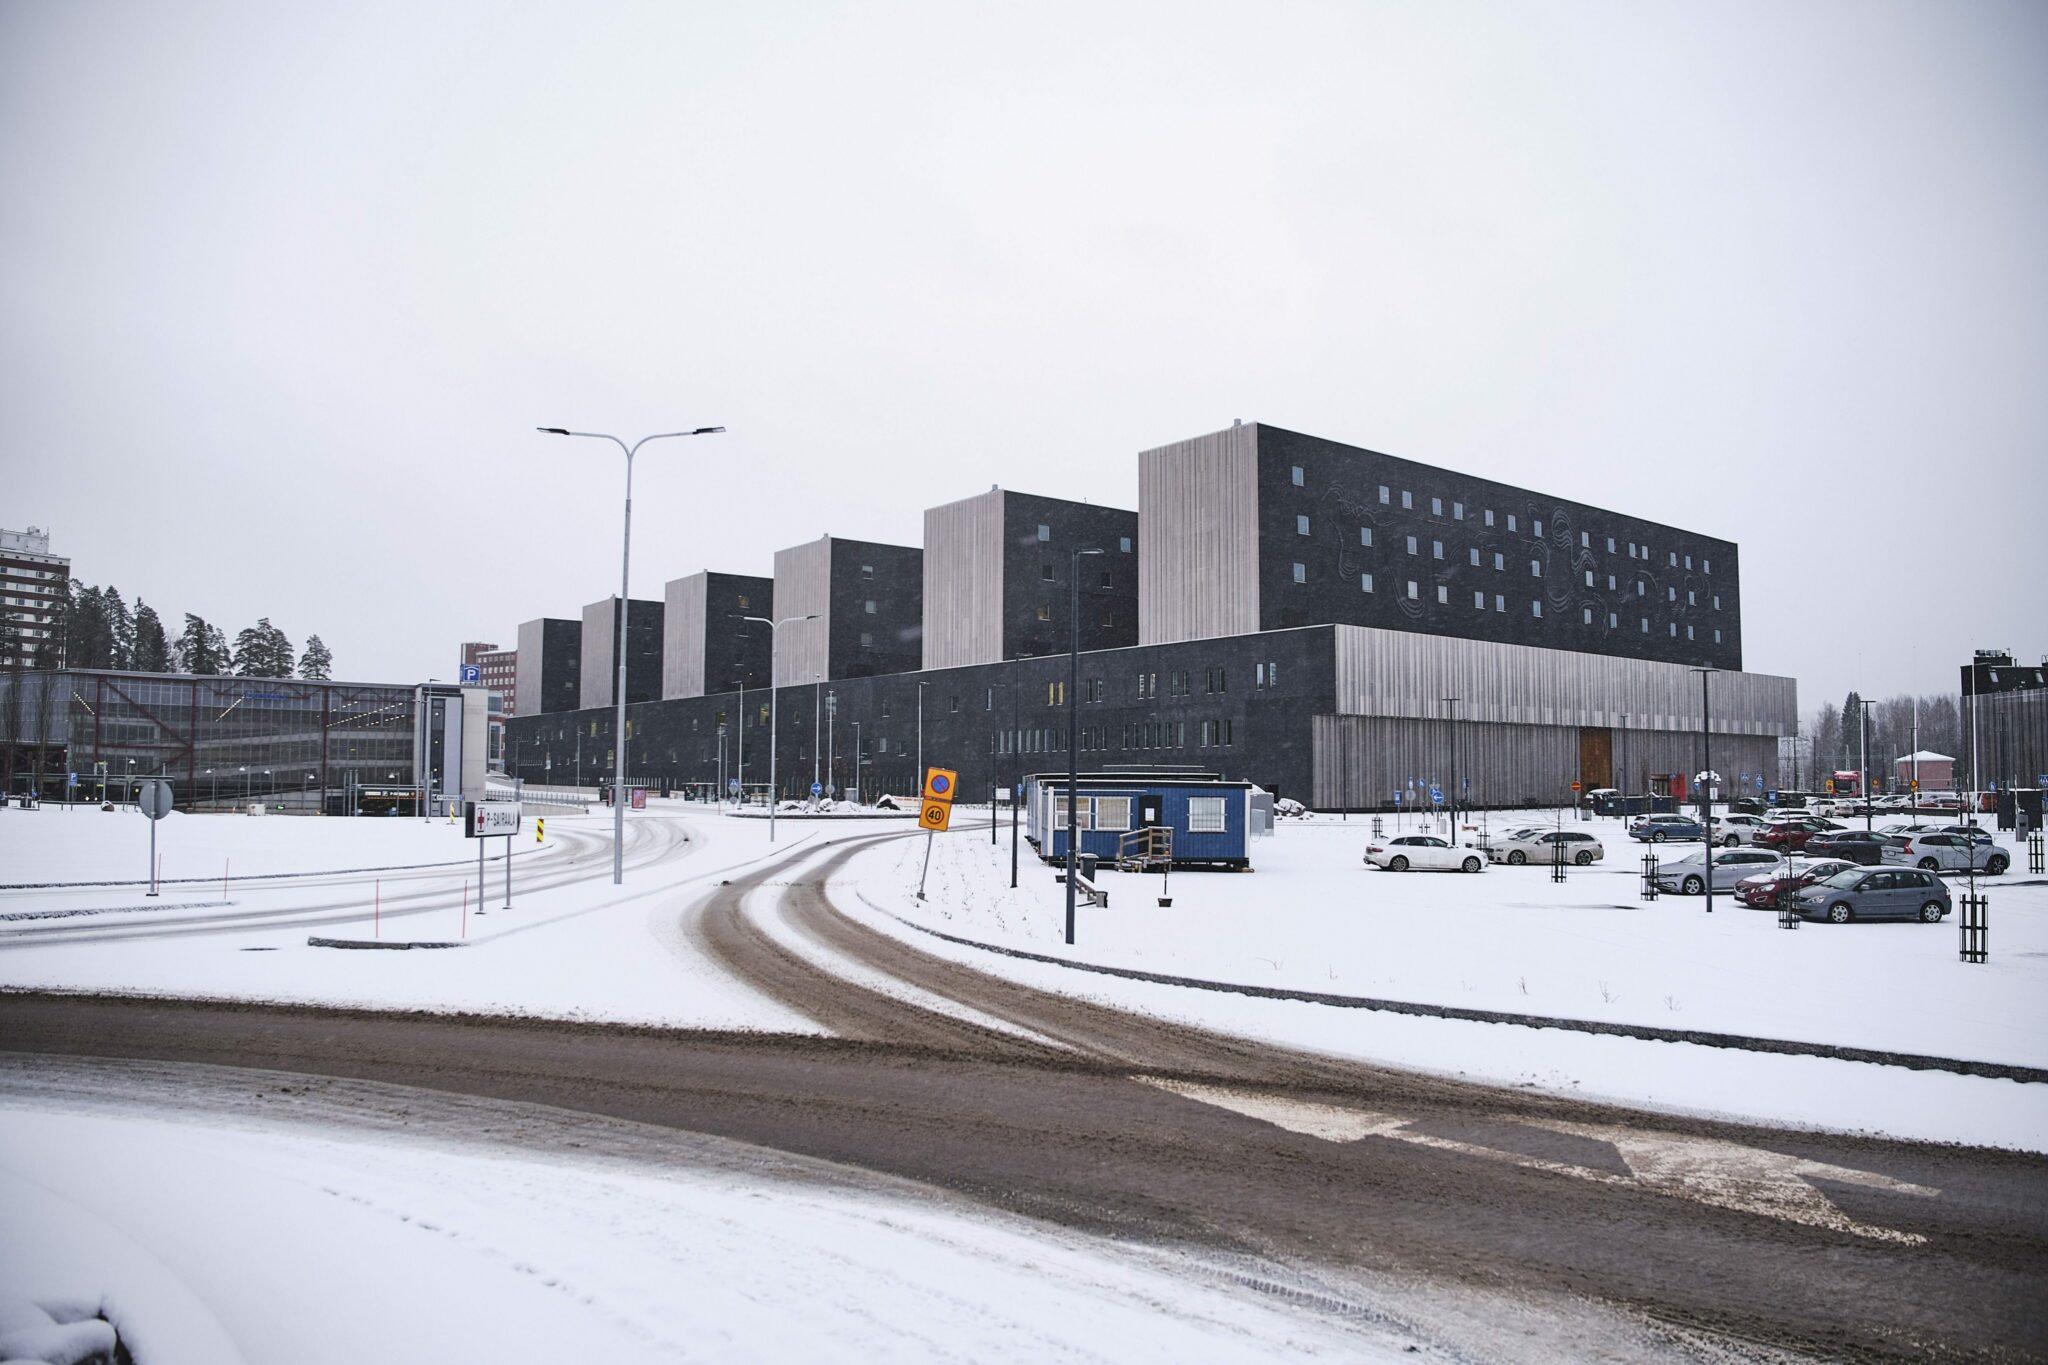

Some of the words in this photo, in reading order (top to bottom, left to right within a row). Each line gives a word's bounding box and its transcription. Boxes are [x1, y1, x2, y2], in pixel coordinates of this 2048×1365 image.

[467, 669, 476, 680] P
[486, 812, 515, 827] P-SAIRAALA
[928, 810, 941, 821] 40
